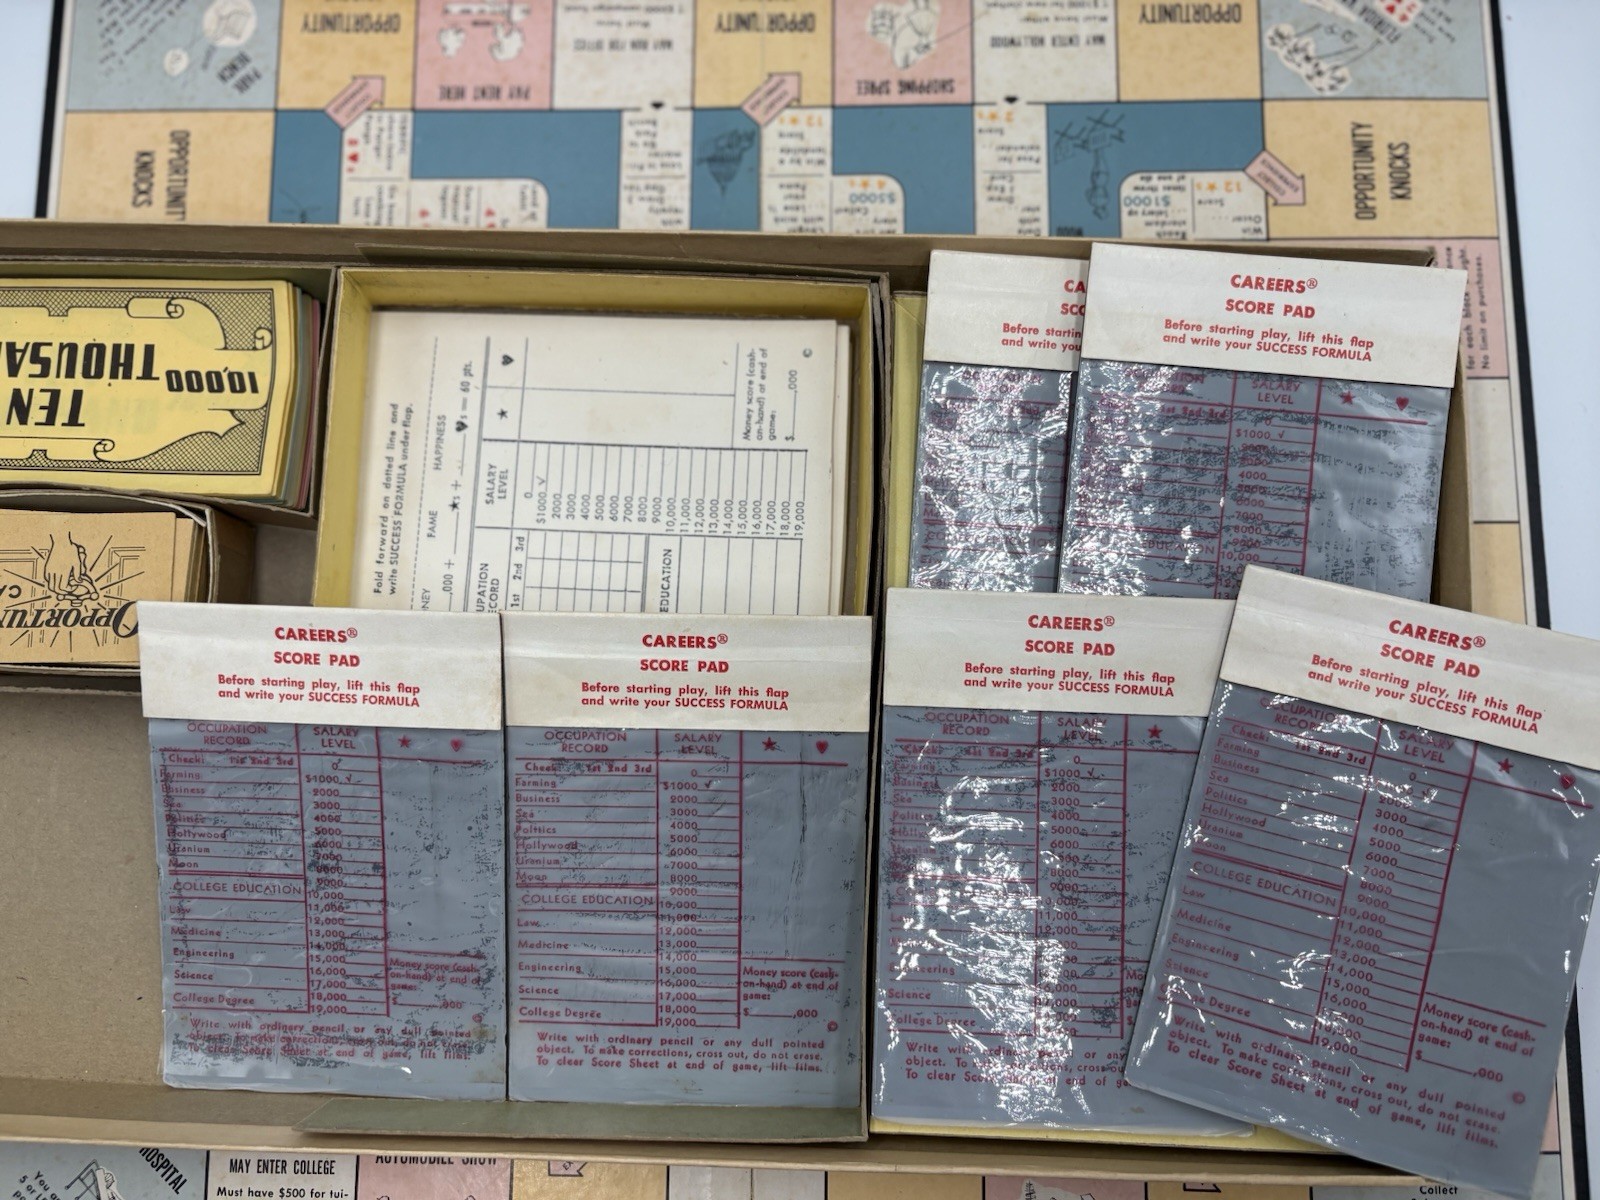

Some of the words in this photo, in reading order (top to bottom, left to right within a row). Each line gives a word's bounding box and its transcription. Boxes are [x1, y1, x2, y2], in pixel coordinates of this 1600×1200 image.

[300, 12, 402, 34] OPPORTUNITY
[714, 12, 817, 33] OPPORUNITY
[1138, 3, 1242, 24] OPPORTUNITY
[855, 79, 891, 97] SPREE
[897, 79, 956, 96] SHOPPING
[132, 150, 156, 209] KNOCKS
[166, 129, 191, 221] OPPORTUNIT
[1352, 121, 1377, 222] OPPORTUNITY
[1391, 141, 1412, 201] KNOCKS
[847, 192, 897, 204] $5000
[1123, 195, 1171, 207] $1000
[1225, 298, 1275, 316] SCORE
[1282, 303, 1317, 319] PAD
[1002, 322, 1039, 336] Before
[1164, 318, 1203, 332] Before
[1208, 324, 1255, 339] starting
[1260, 328, 1292, 342] play,
[1298, 331, 1316, 344] lift
[1321, 333, 1344, 347] this
[1349, 335, 1375, 350] flap
[1001, 336, 1024, 348] and
[1028, 339, 1057, 350] write
[1162, 333, 1186, 345] and
[1190, 336, 1222, 348] write
[1224, 339, 1252, 352] your
[1256, 340, 1308, 356] SUCCESS
[1311, 346, 1373, 362] FORMULA
[0, 341, 160, 380] THOUSA
[165, 366, 260, 394] 10,000
[6, 388, 86, 427] TEN
[391, 403, 399, 424] and
[404, 403, 414, 429] flap.
[386, 429, 397, 451] line
[402, 429, 411, 460] under
[433, 414, 446, 471] HAPPINESS
[383, 456, 394, 490] dotted
[485, 463, 498, 505] SALARY
[497, 468, 509, 500] LEVEL
[395, 463, 407, 517] FORMULA
[382, 495, 391, 509] on
[536, 491, 547, 524] $1000
[551, 493, 562, 519] 2000
[580, 494, 591, 520] 4000
[609, 495, 619, 522] 6000
[427, 510, 438, 538] FAME
[665, 497, 676, 533] 10,000
[694, 498, 705, 534] 12,000
[751, 500, 762, 535] 16,000
[780, 501, 791, 536] 18,000
[794, 501, 805, 537] 19,000
[376, 515, 388, 566] forward
[392, 519, 403, 566] SUCCESS
[514, 535, 525, 552] 3rd
[373, 571, 384, 594] Fold
[389, 568, 398, 596] write
[659, 548, 672, 613] EDUCATION
[0, 600, 139, 638] OPPORTU
[273, 650, 321, 667] SCORE
[328, 653, 361, 668] PAD
[1024, 638, 1075, 655] SCORE
[1082, 641, 1116, 657] PAD
[639, 658, 689, 673] SCORE
[696, 659, 730, 674] PAD
[1379, 642, 1435, 668] SCORE
[1443, 658, 1482, 679] PAD
[217, 673, 255, 686] Before
[261, 676, 305, 691] starting
[311, 678, 341, 692] play,
[346, 678, 363, 692] lift
[369, 680, 392, 693] this
[396, 682, 421, 696] flap
[963, 661, 1004, 675] Before
[1009, 665, 1056, 680] starting
[1062, 668, 1093, 682] play,
[1098, 667, 1118, 681] lift
[1122, 669, 1146, 682] this
[1151, 671, 1176, 685] flap
[217, 688, 241, 699] and
[244, 689, 275, 701] write
[278, 692, 304, 703] your
[308, 691, 358, 705] SUCCESS
[361, 693, 420, 708] FORMULA
[580, 681, 620, 694] Before
[626, 683, 672, 697] starting
[677, 684, 708, 698] play,
[714, 684, 732, 697] lift
[737, 685, 760, 698] this
[765, 685, 790, 699] flap
[963, 677, 988, 688] and
[991, 678, 1023, 690] write
[1026, 681, 1054, 692] your
[1058, 680, 1110, 694] SUCCESS
[1114, 682, 1175, 698] FORMULA
[1311, 654, 1354, 674] Before
[1358, 668, 1410, 689] starting
[1415, 681, 1450, 699] play,
[1457, 687, 1479, 703] lift
[1483, 695, 1510, 713] this
[1515, 702, 1544, 721] flap
[580, 695, 605, 707] and
[608, 696, 640, 708] write
[643, 698, 671, 709] your
[674, 696, 726, 709] SUCCESS
[729, 698, 789, 711] FORMULA
[1307, 669, 1333, 684] and
[1337, 677, 1372, 694] write
[1374, 685, 1406, 702] your
[1409, 692, 1469, 716] SUCCESS
[1471, 706, 1540, 735] FORMULA
[187, 722, 268, 735] OCCUPATION
[544, 731, 627, 743] OCCUPATION
[561, 743, 609, 753] RECORD
[1193, 861, 1252, 885] COLLEGE
[1257, 878, 1337, 908] EDUCATION
[521, 894, 577, 905] COLLEGE
[581, 895, 654, 906] EDUCATION
[518, 962, 582, 974] Engineering
[518, 985, 559, 995] Science
[519, 1006, 561, 1018] College
[564, 1008, 602, 1020] Degree
[1209, 996, 1251, 1018] Degree
[1423, 1002, 1464, 1024] Money
[1467, 1017, 1498, 1033] score
[537, 1044, 574, 1054] object.
[591, 1057, 622, 1068] Score
[629, 1058, 659, 1069] Sheet
[229, 1158, 252, 1174] MAY
[256, 1159, 288, 1175] ENTER
[293, 1160, 336, 1176] COLLEGE
[33, 1171, 50, 1192] You
[1420, 1185, 1458, 1195] Collect
[216, 1187, 244, 1198] Must
[247, 1187, 274, 1198] have
[278, 1187, 306, 1199] $500
[310, 1188, 327, 1199] for
[330, 1189, 349, 1200] tui-
